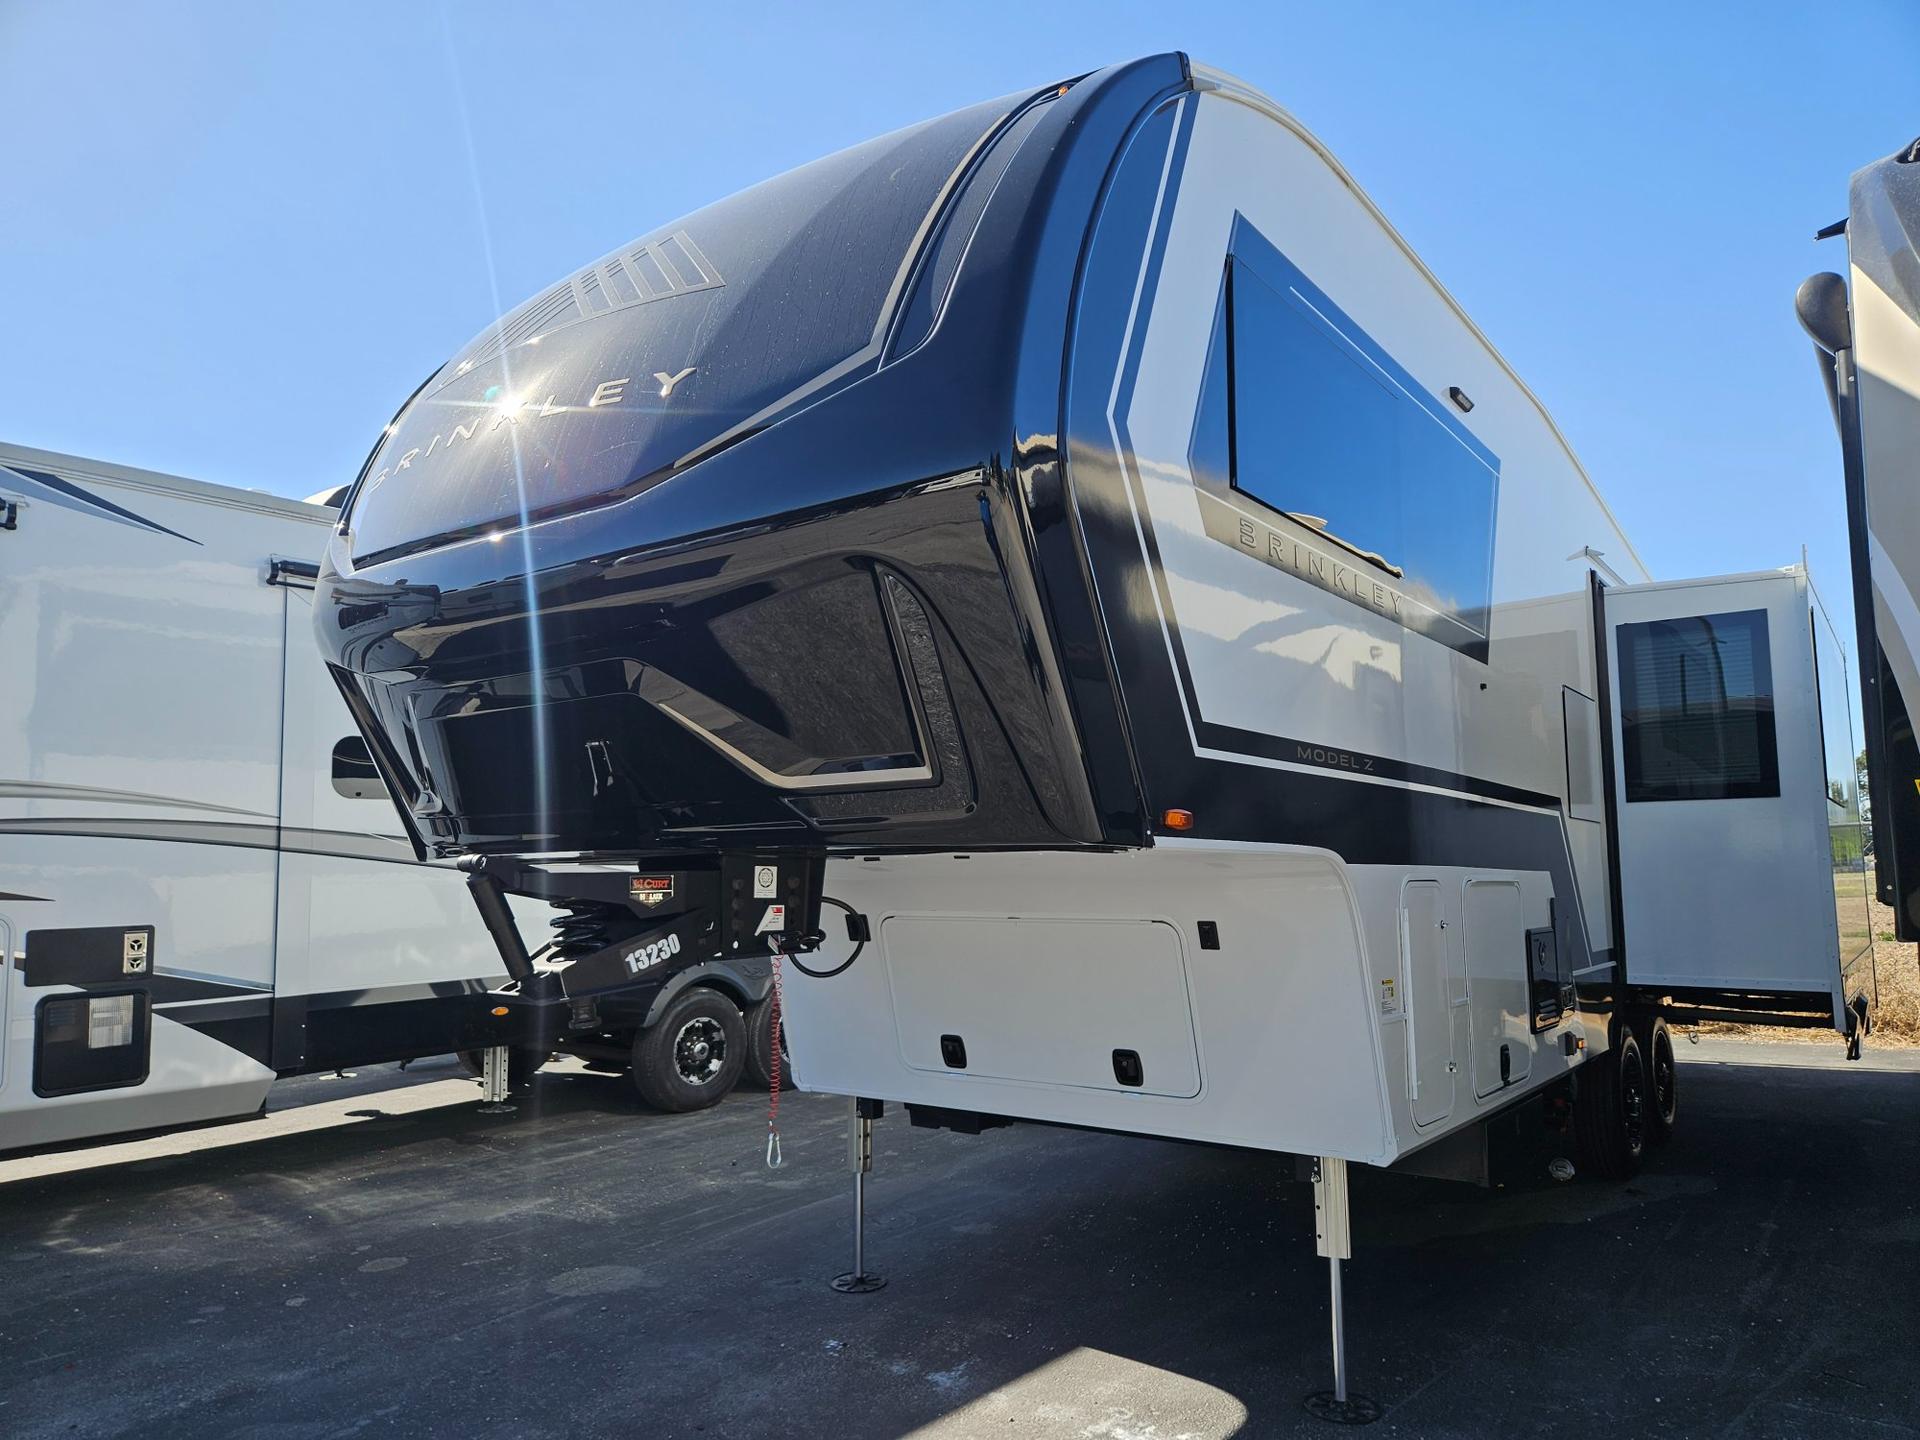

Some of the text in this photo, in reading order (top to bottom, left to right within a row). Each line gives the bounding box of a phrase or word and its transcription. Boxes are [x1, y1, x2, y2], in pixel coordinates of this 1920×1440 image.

[1239, 517, 1401, 616] BRINKLEY
[1297, 746, 1375, 771] MODEL Z
[624, 933, 681, 974] 13230
